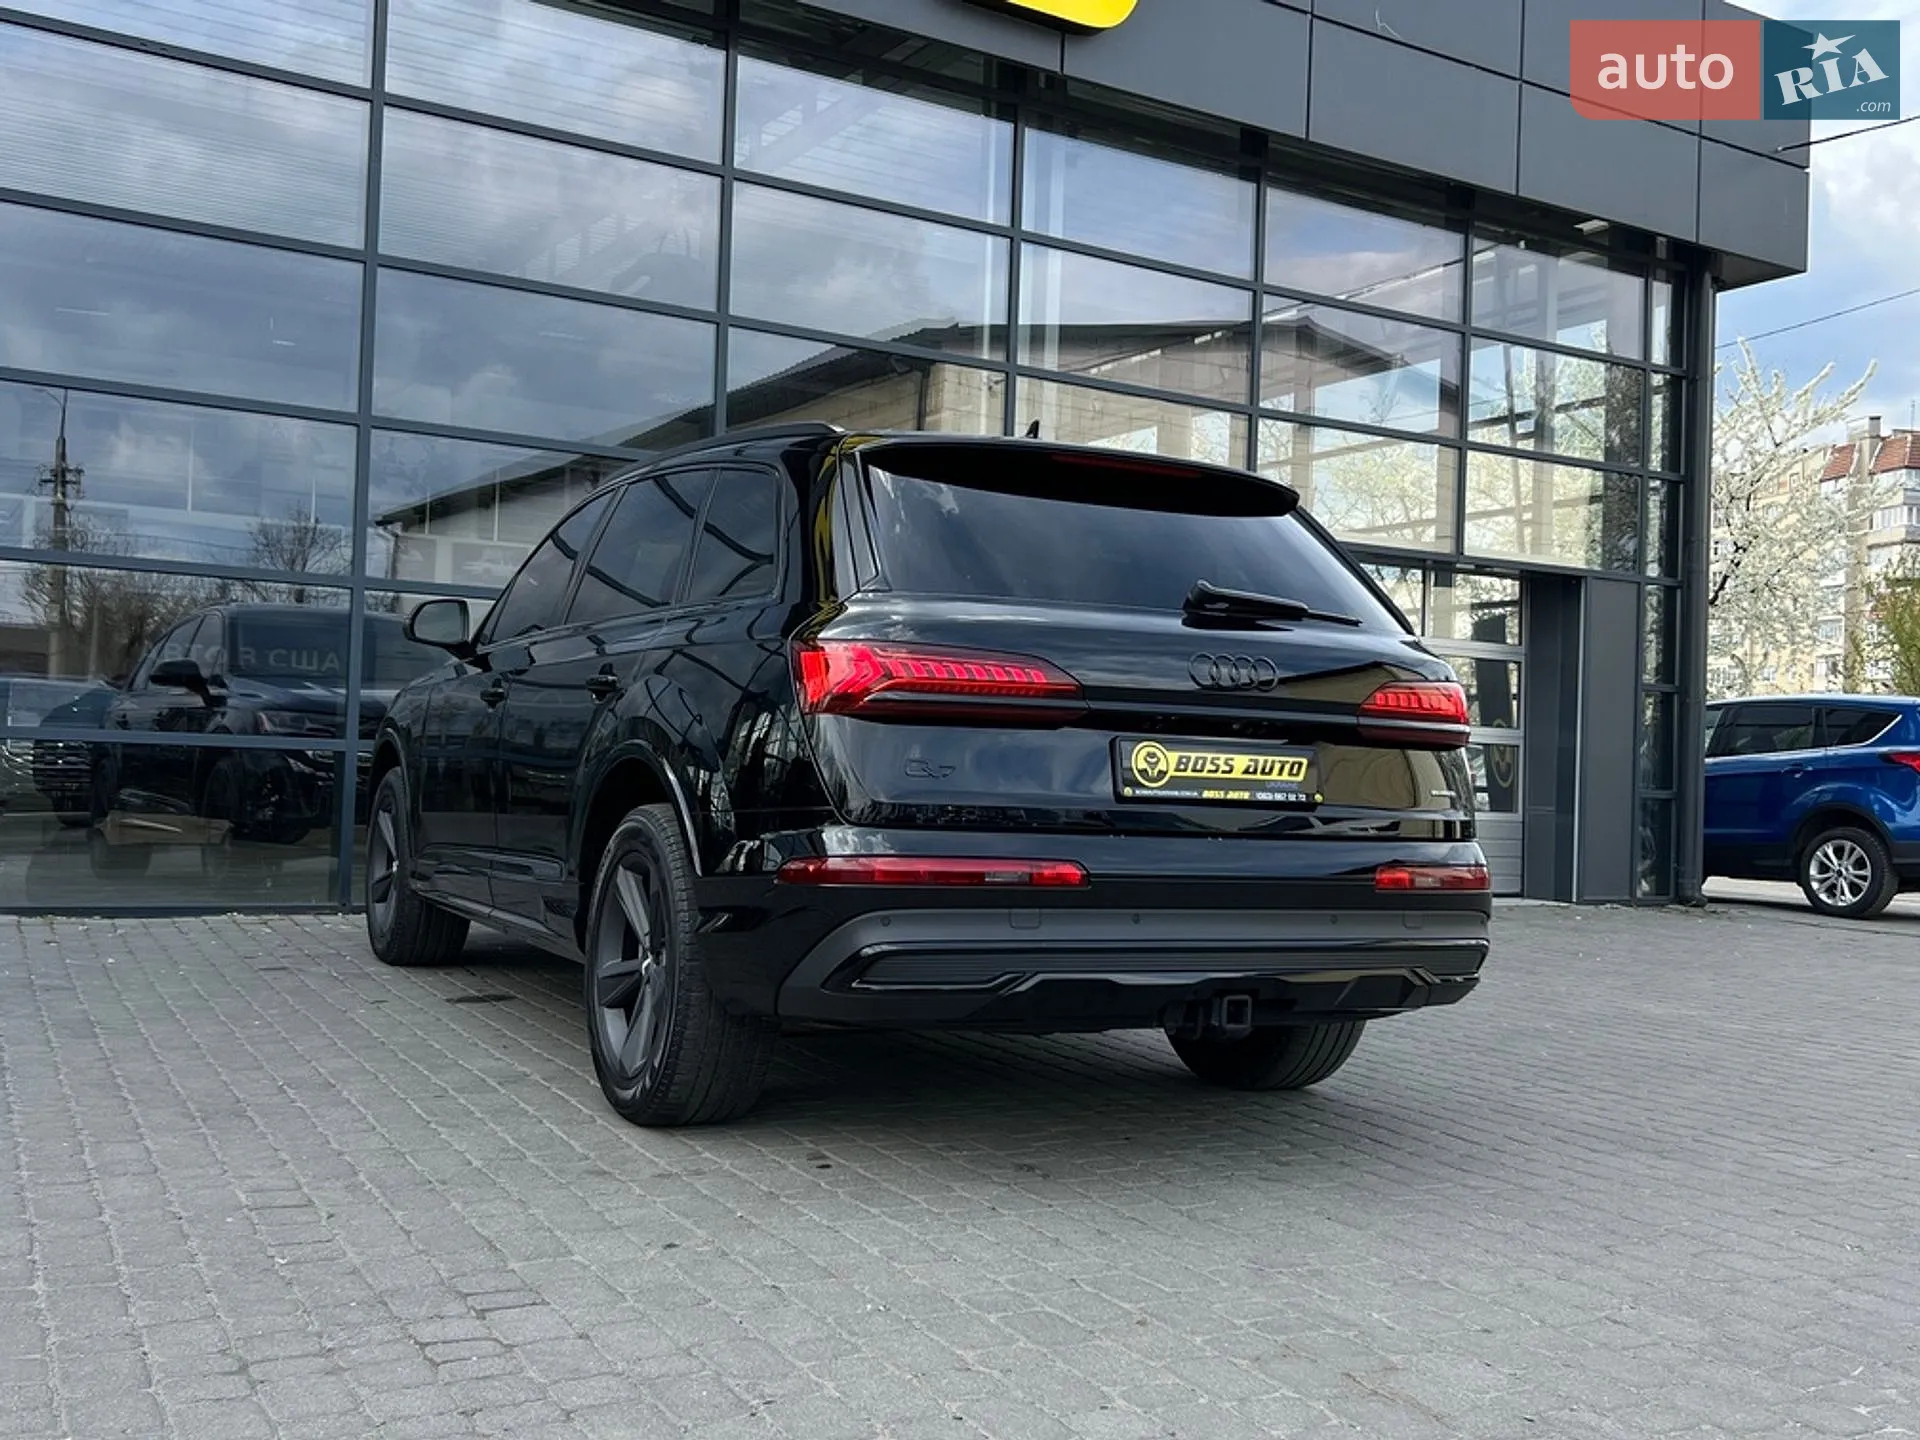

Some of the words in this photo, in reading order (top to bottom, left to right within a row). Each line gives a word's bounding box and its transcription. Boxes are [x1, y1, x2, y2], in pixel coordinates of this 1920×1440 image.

[267, 648, 340, 673] США
[1174, 755, 1235, 775] BOSS
[1241, 758, 1304, 777] AUTO
